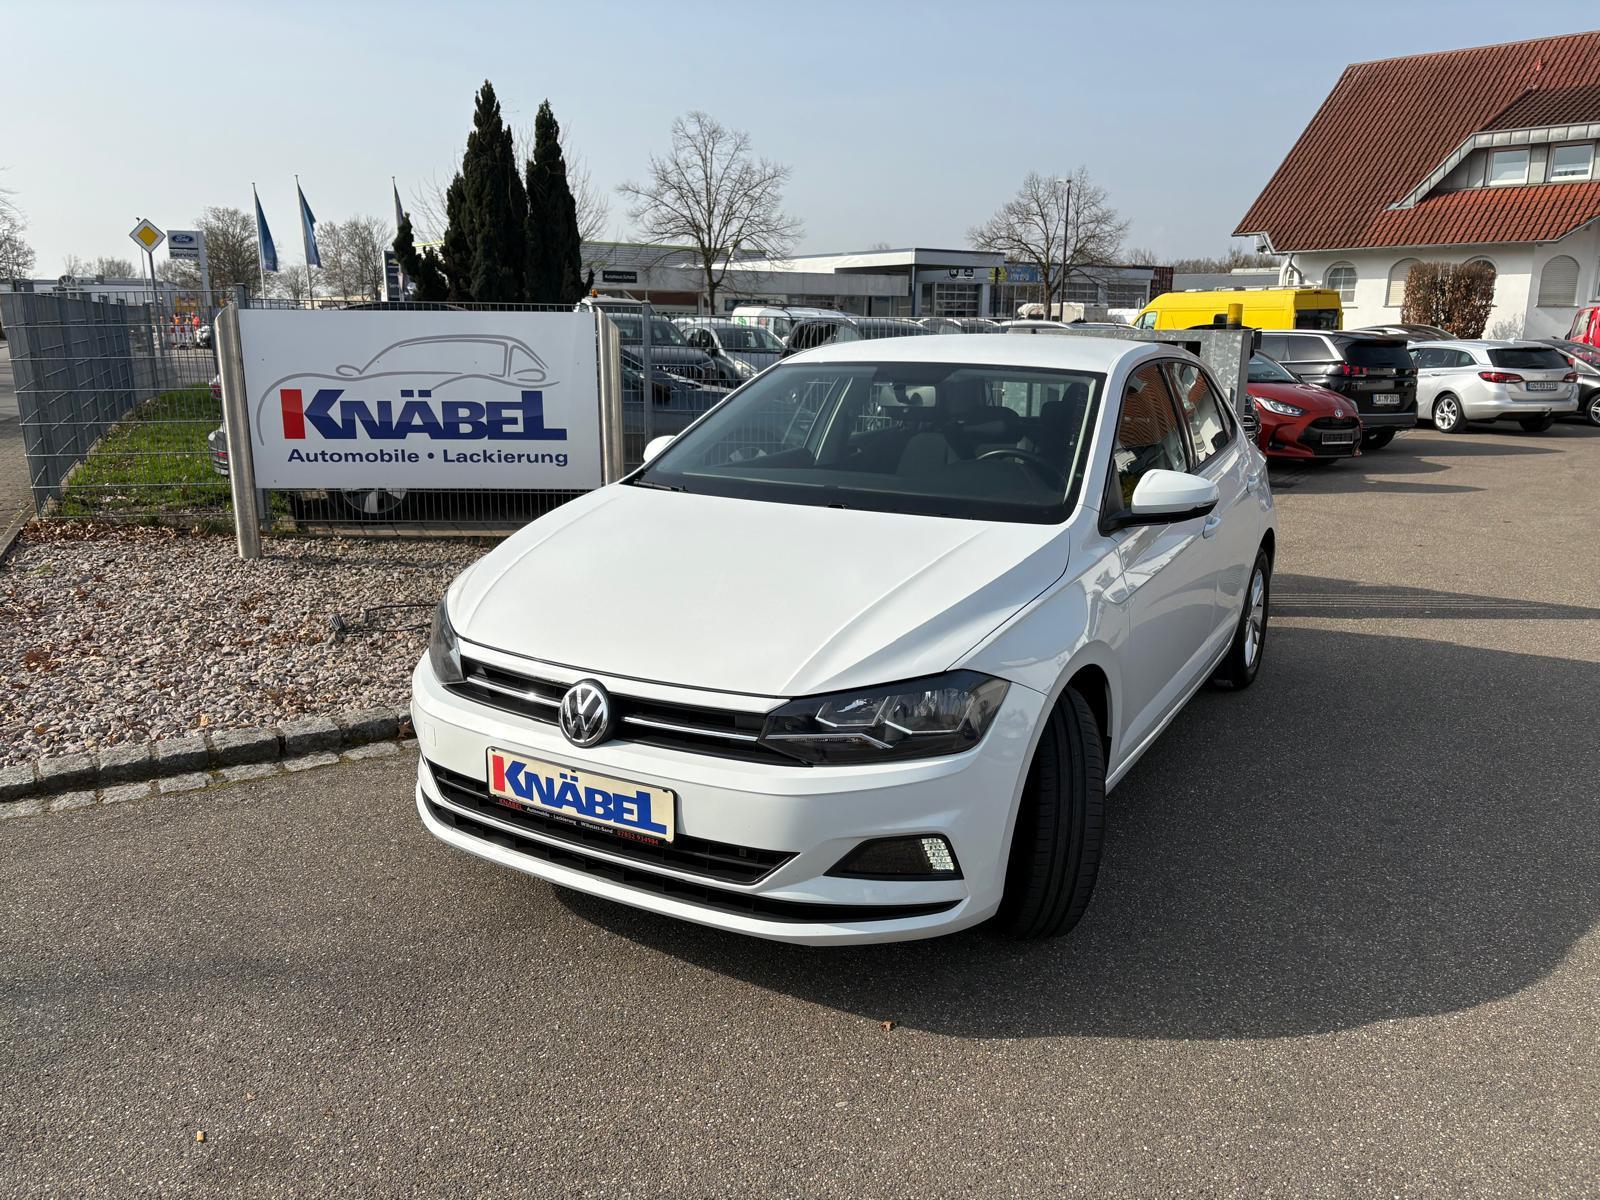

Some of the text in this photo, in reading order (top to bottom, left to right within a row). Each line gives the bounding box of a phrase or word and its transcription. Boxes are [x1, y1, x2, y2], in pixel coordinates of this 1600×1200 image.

[280, 388, 567, 441] KNÄBEL
[287, 448, 568, 468] Automobile Lackierung
[492, 754, 667, 835] KNÄBEL
[553, 814, 577, 826] Lackierung
